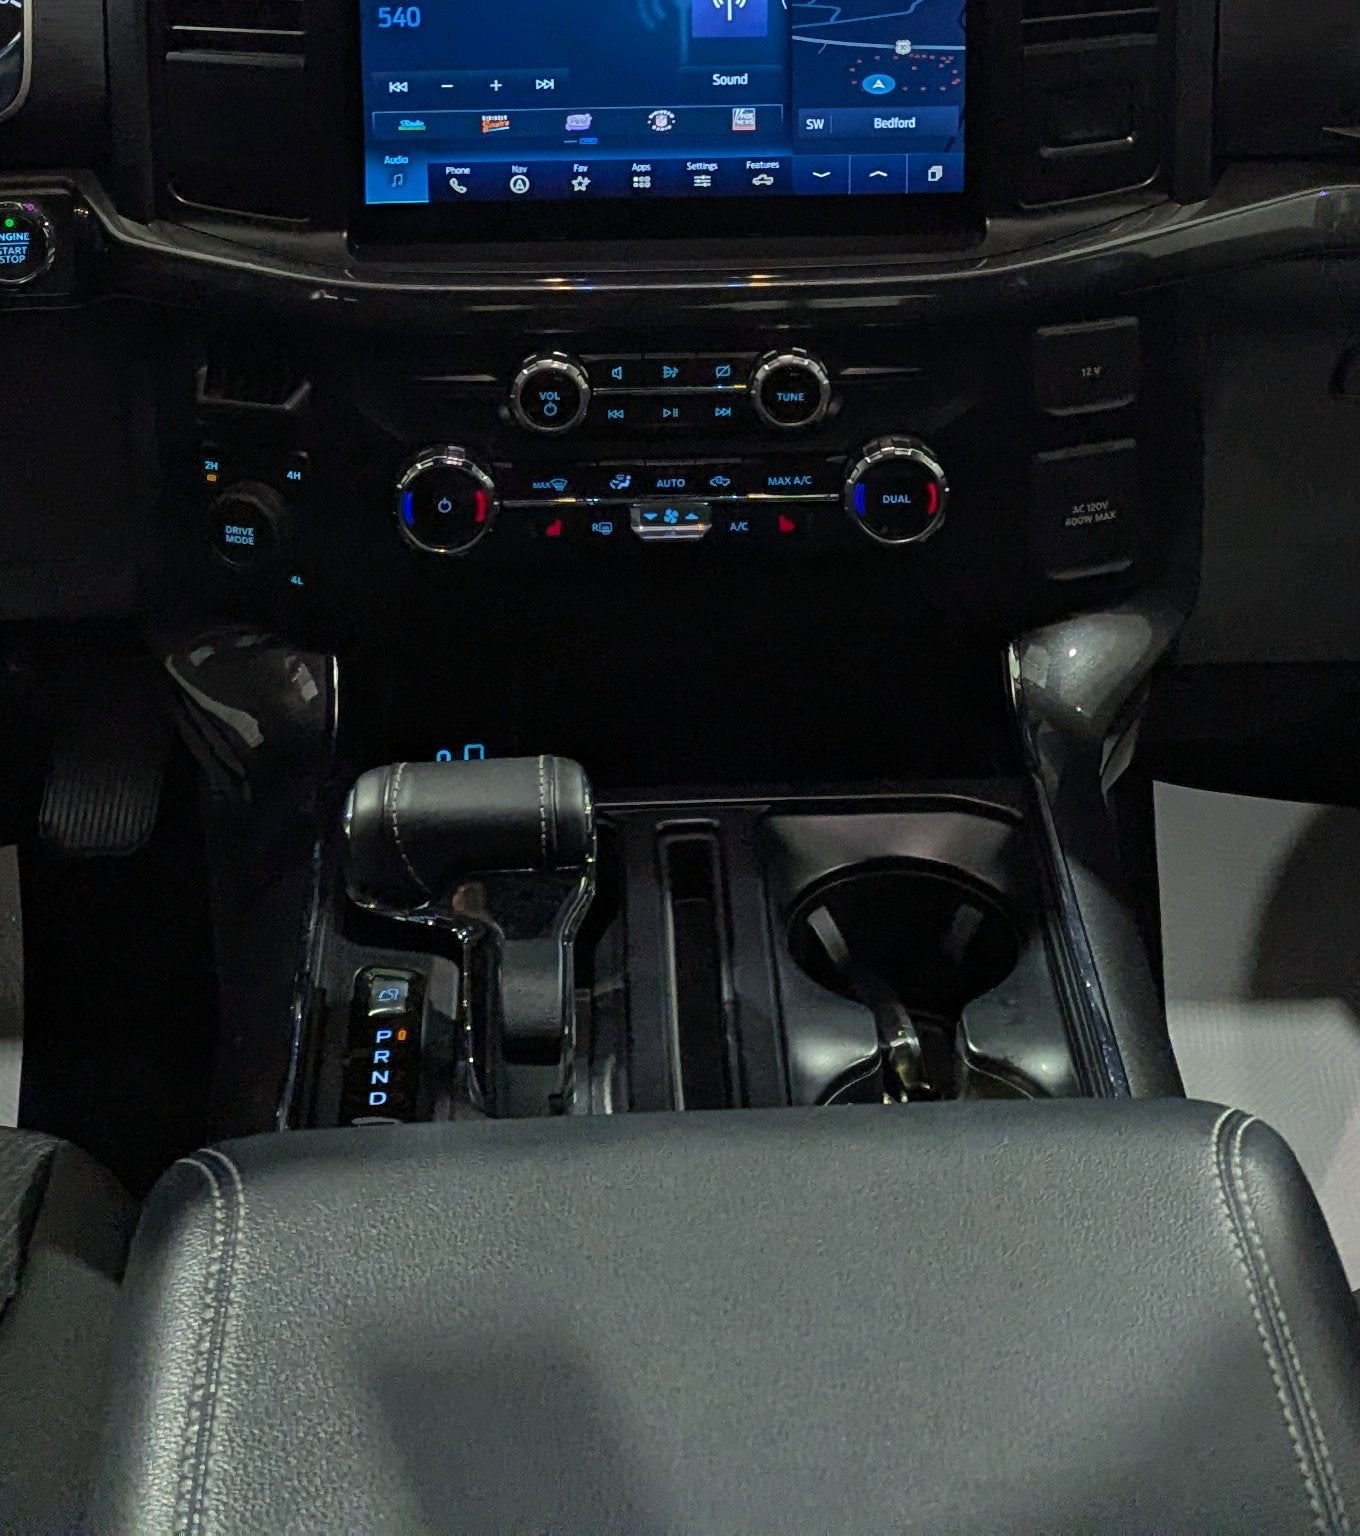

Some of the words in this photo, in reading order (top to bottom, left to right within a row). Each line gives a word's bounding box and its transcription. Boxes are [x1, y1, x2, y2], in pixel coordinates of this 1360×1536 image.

[378, 6, 421, 28] 540
[712, 73, 748, 86] Sound
[806, 118, 824, 130] SW
[874, 117, 916, 129] Bedford
[384, 155, 409, 165] Audio
[746, 160, 780, 170] Features
[445, 166, 471, 175] Phone
[511, 165, 528, 174] Nav
[573, 164, 589, 173] Fav
[631, 163, 652, 173] Apps
[686, 162, 718, 172] Settings
[539, 392, 561, 401] VOL
[777, 392, 805, 402] TUNE
[204, 460, 219, 471] 2H
[286, 471, 301, 481] 4H
[767, 476, 792, 486] MAX
[793, 475, 813, 486] A/C
[532, 481, 552, 489] MAX
[656, 478, 686, 488] AUTO
[882, 494, 912, 504] DUAL
[225, 525, 255, 536] DRIVE
[729, 521, 749, 532] A/C
[225, 534, 255, 545] MODE
[290, 576, 304, 586] 4L
[376, 1029, 392, 1043] P
[373, 1050, 390, 1063] R
[370, 1070, 389, 1084] N
[368, 1092, 387, 1106] D
